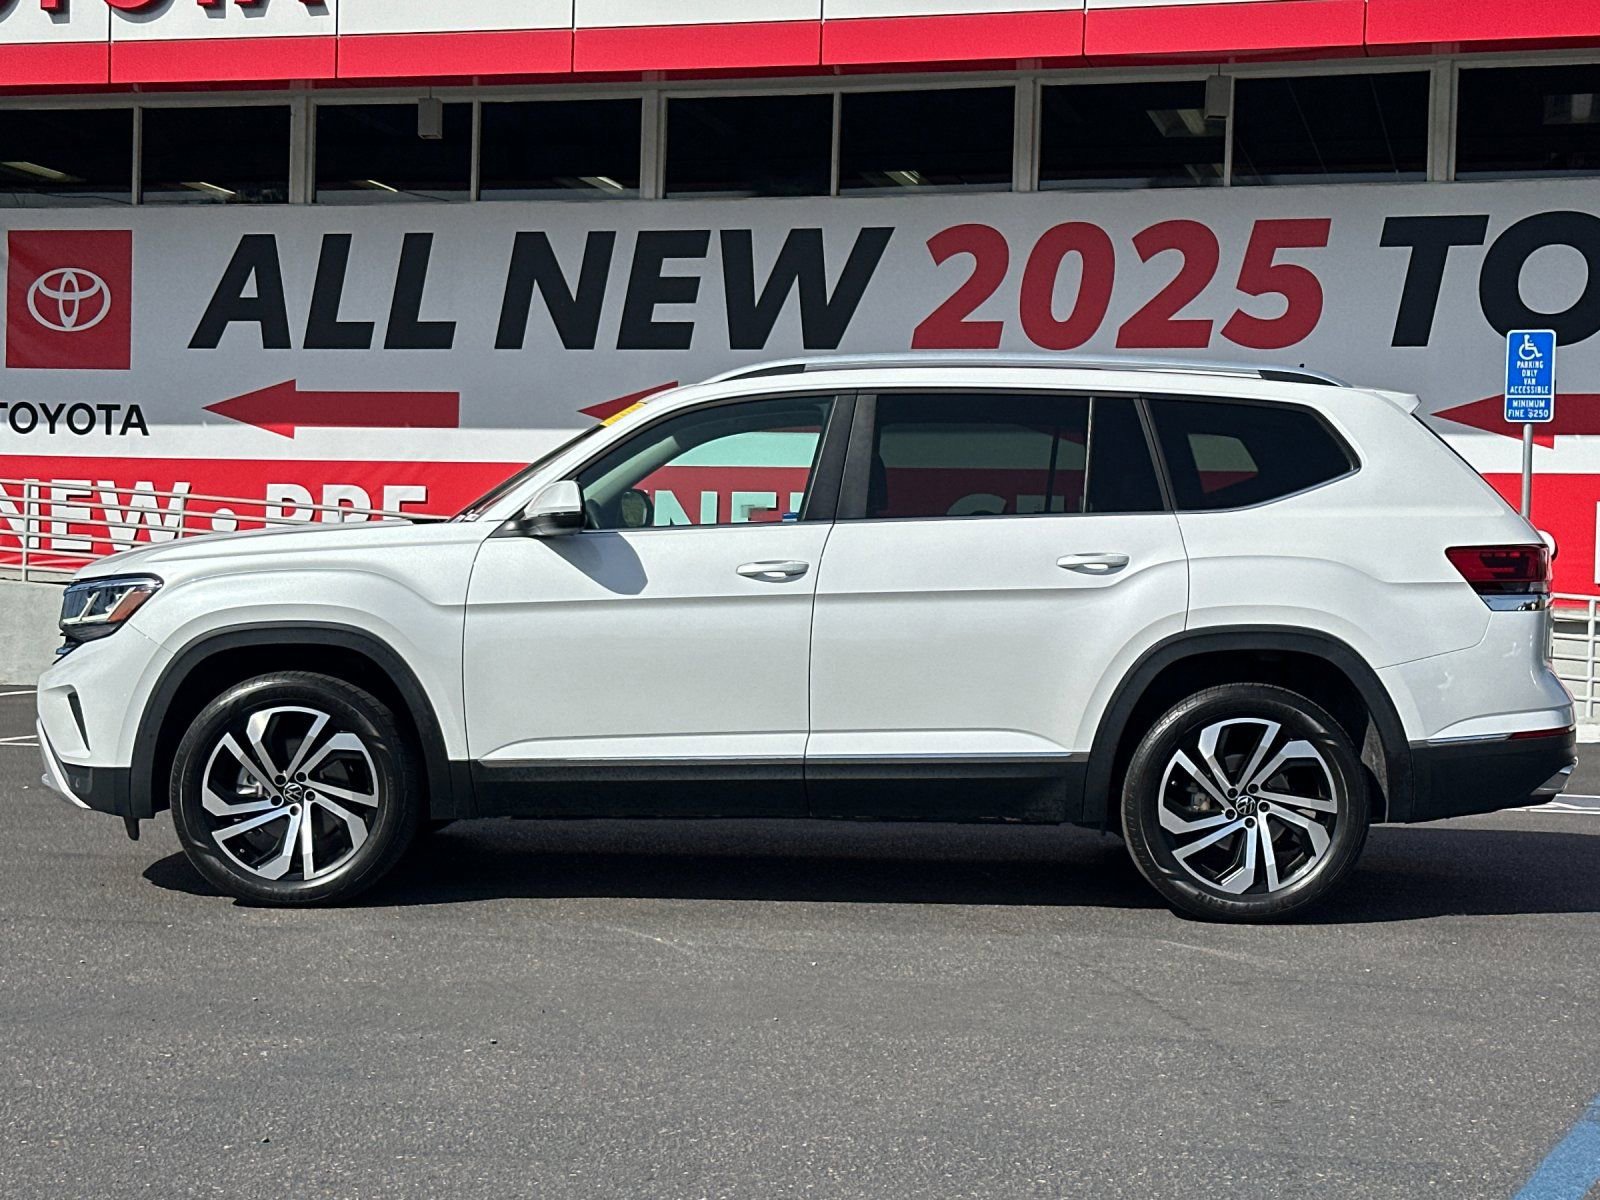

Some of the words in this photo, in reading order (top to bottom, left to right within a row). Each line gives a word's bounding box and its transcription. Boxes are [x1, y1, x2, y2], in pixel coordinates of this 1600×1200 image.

[187, 232, 457, 350] ALL
[494, 226, 896, 351] NEW
[911, 217, 1332, 350] 2025
[1379, 210, 1600, 349] TO
[1516, 360, 1544, 369] PARKING
[1521, 369, 1538, 377] ONLY
[1510, 385, 1549, 394] ACCESSIBLE
[1512, 399, 1546, 408] MINIMUM
[1508, 408, 1525, 418] FINE
